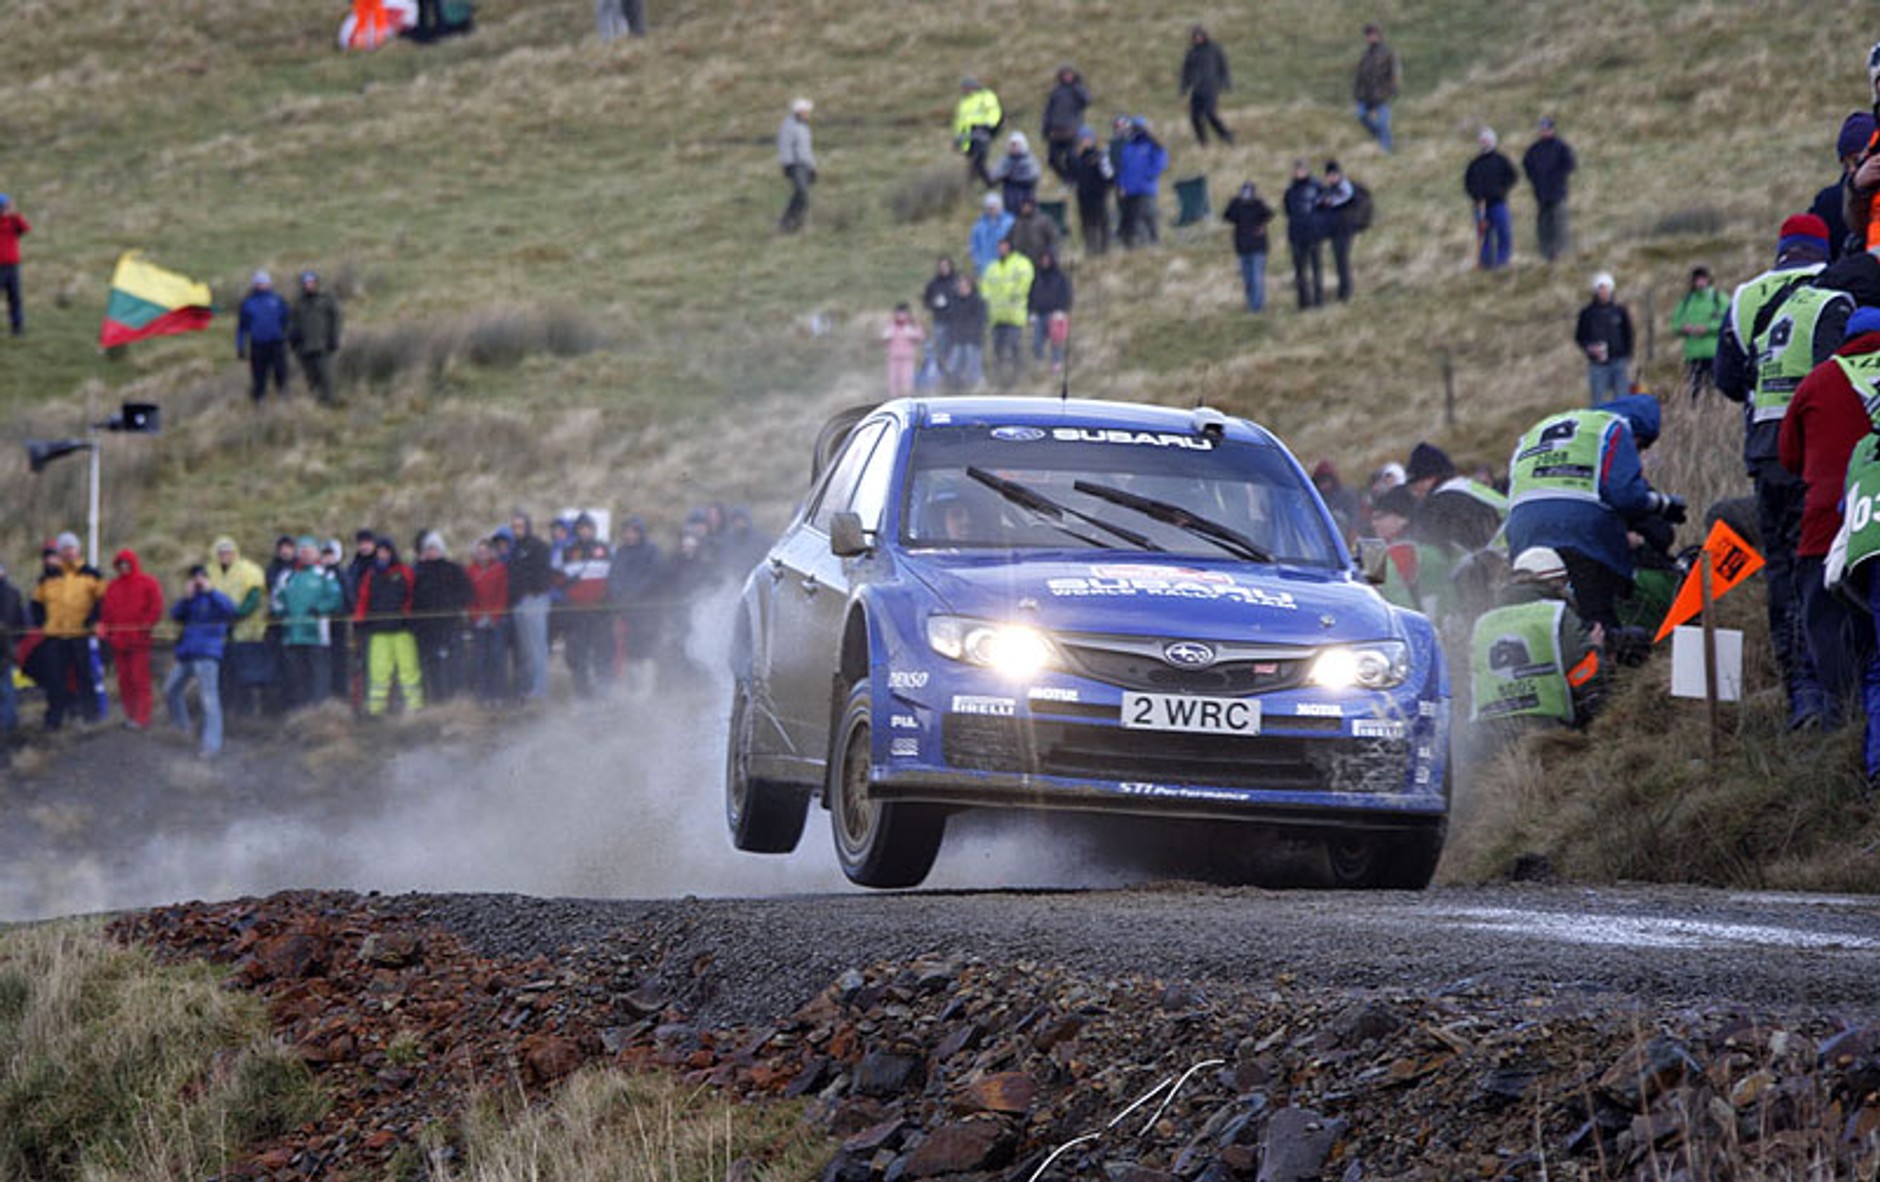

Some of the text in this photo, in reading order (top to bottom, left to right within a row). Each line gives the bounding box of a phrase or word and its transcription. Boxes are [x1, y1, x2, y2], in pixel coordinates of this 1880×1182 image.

[1053, 428, 1212, 450] SUBARU
[1134, 697, 1249, 730] 2 WRC
